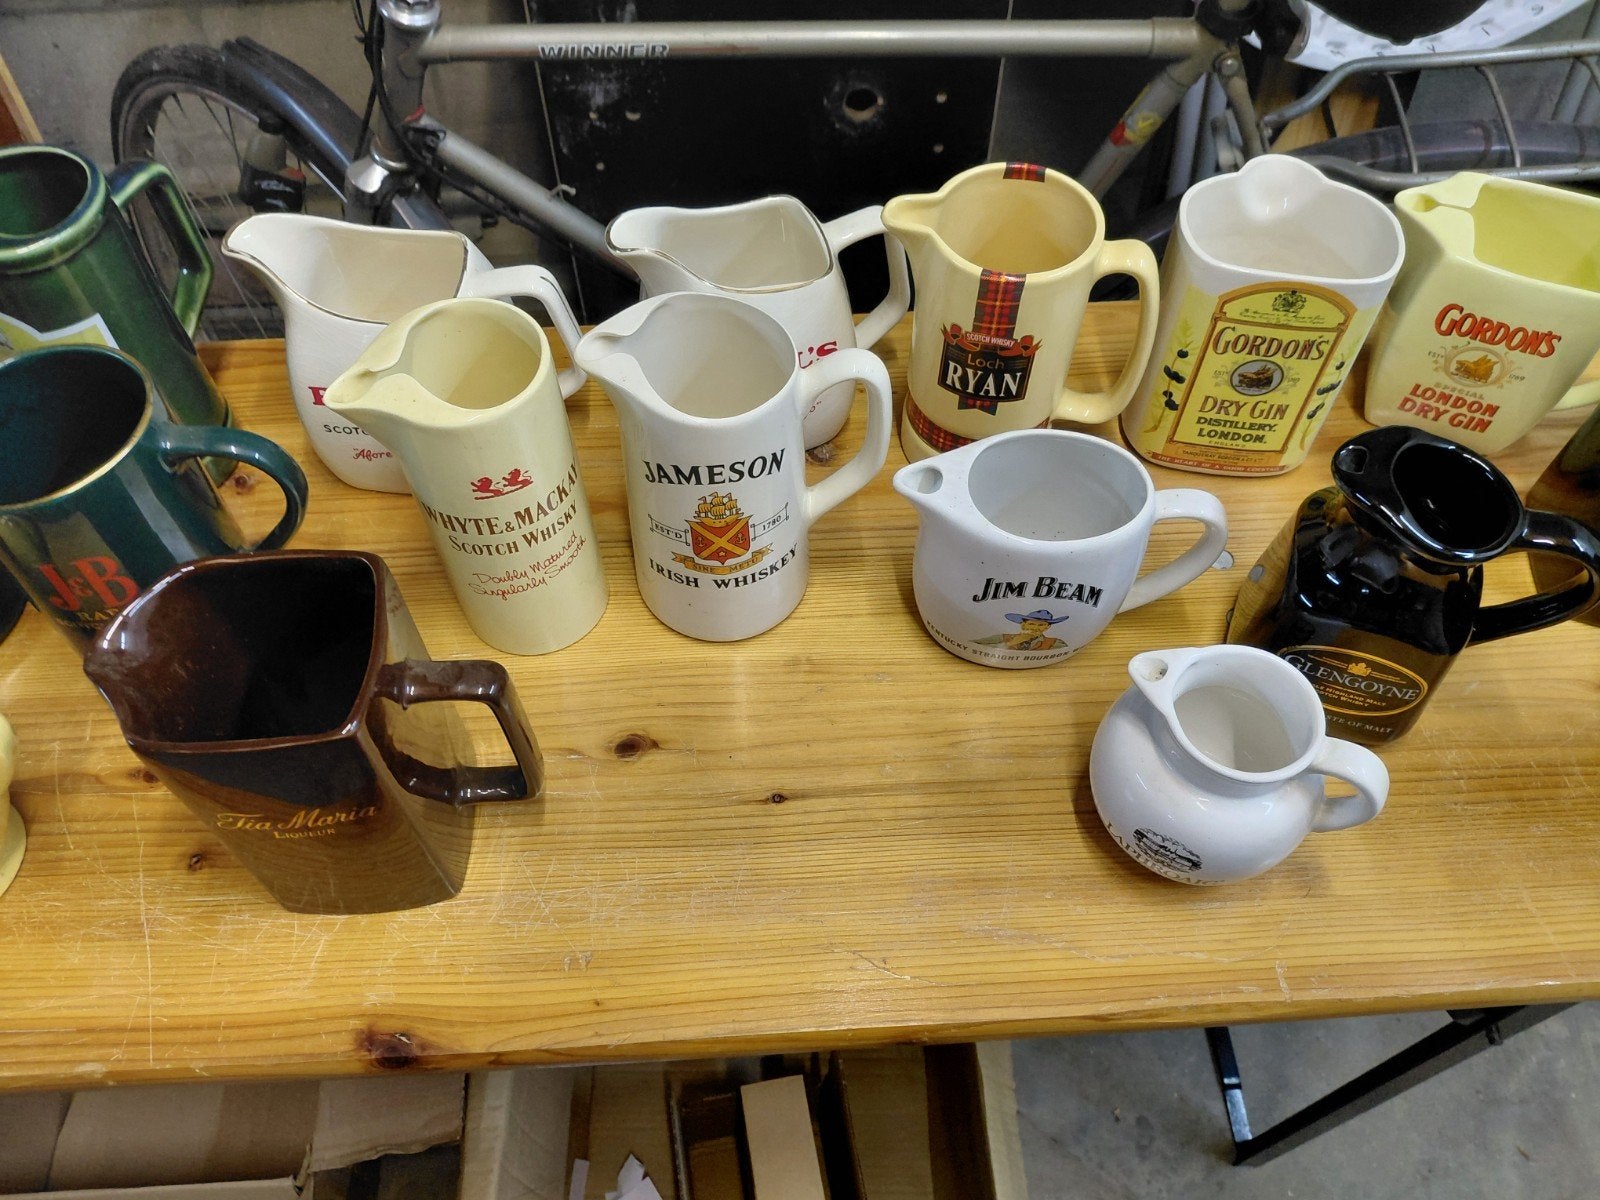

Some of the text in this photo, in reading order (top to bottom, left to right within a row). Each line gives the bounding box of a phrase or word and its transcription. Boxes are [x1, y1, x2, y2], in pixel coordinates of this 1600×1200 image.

[538, 43, 669, 58] WINNER
[966, 332, 1015, 347] SCOTCH WHISKY
[1212, 326, 1330, 360] GORDON'S
[1435, 303, 1562, 358] GORDON'S
[945, 360, 1022, 396] RYAN
[967, 353, 1005, 369] Loch
[1198, 395, 1289, 420] DRY GIN
[1397, 396, 1492, 433] DRY GIN
[1409, 383, 1500, 417] LONDON
[642, 447, 786, 486] JAMESON
[448, 499, 577, 557] SCOTCH WHISKY
[761, 515, 782, 532] 1780
[468, 534, 587, 601] Singularly Smooth
[472, 530, 578, 584] Doubly Matured
[649, 542, 798, 590] IRISH WHISKEY
[39, 556, 138, 611] J&B
[972, 576, 1104, 608] JIM BEAM
[926, 619, 969, 652] KENTUCKY
[971, 648, 1021, 661] STRAIGHT
[1284, 654, 1420, 701] GLENGOYNE
[1325, 687, 1364, 702] HIGHLAND
[1365, 698, 1387, 706] MALT
[1364, 724, 1393, 733] MALT
[217, 806, 377, 830] Tia Maria
[273, 828, 336, 839] LIQUEUR
